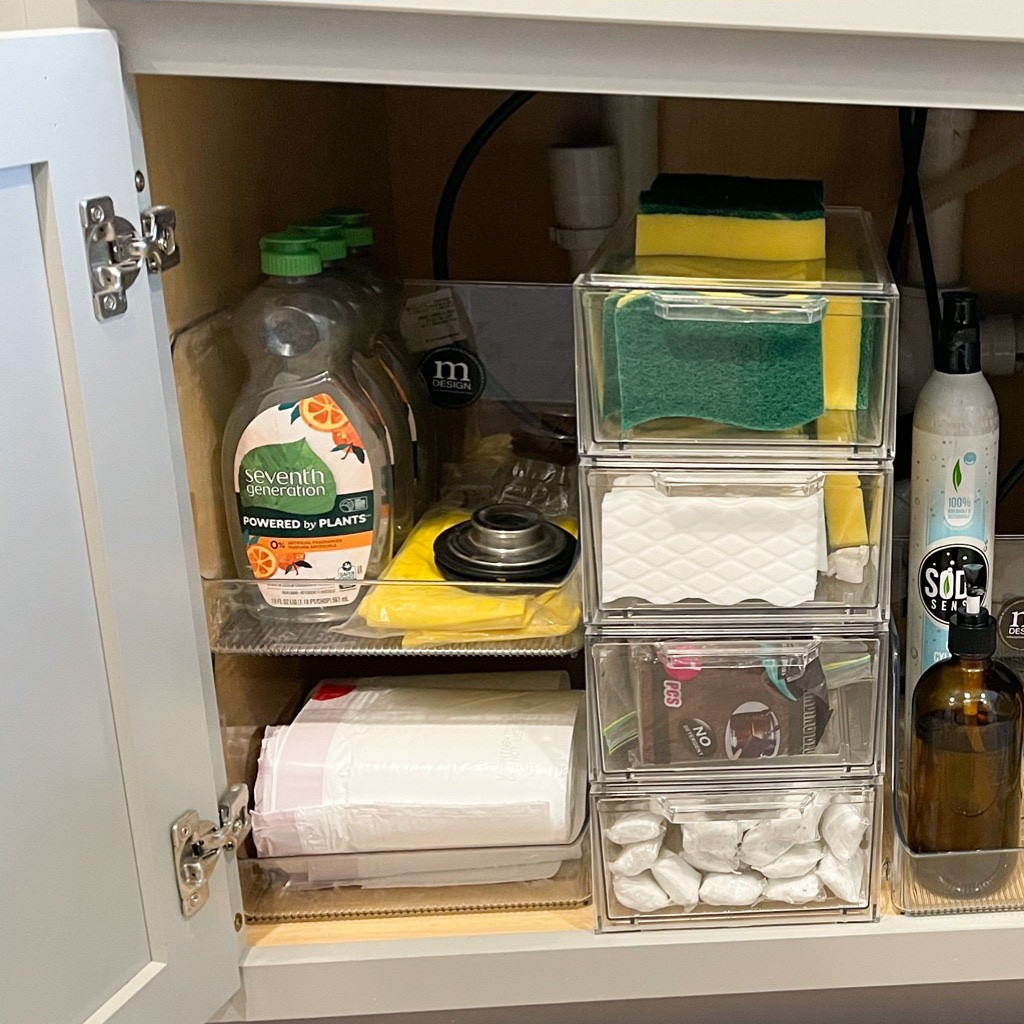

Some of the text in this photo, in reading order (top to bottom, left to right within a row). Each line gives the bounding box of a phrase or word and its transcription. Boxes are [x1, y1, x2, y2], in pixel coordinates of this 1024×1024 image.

[432, 379, 471, 390] DESIGN
[245, 468, 325, 485] seventh
[246, 484, 326, 497] generation
[948, 497, 971, 508] 100%
[243, 514, 367, 531] POWERED by PLANTS
[270, 540, 285, 550] 0%
[925, 567, 967, 600] SOD
[664, 679, 682, 708] PCS
[693, 726, 712, 747] NO
